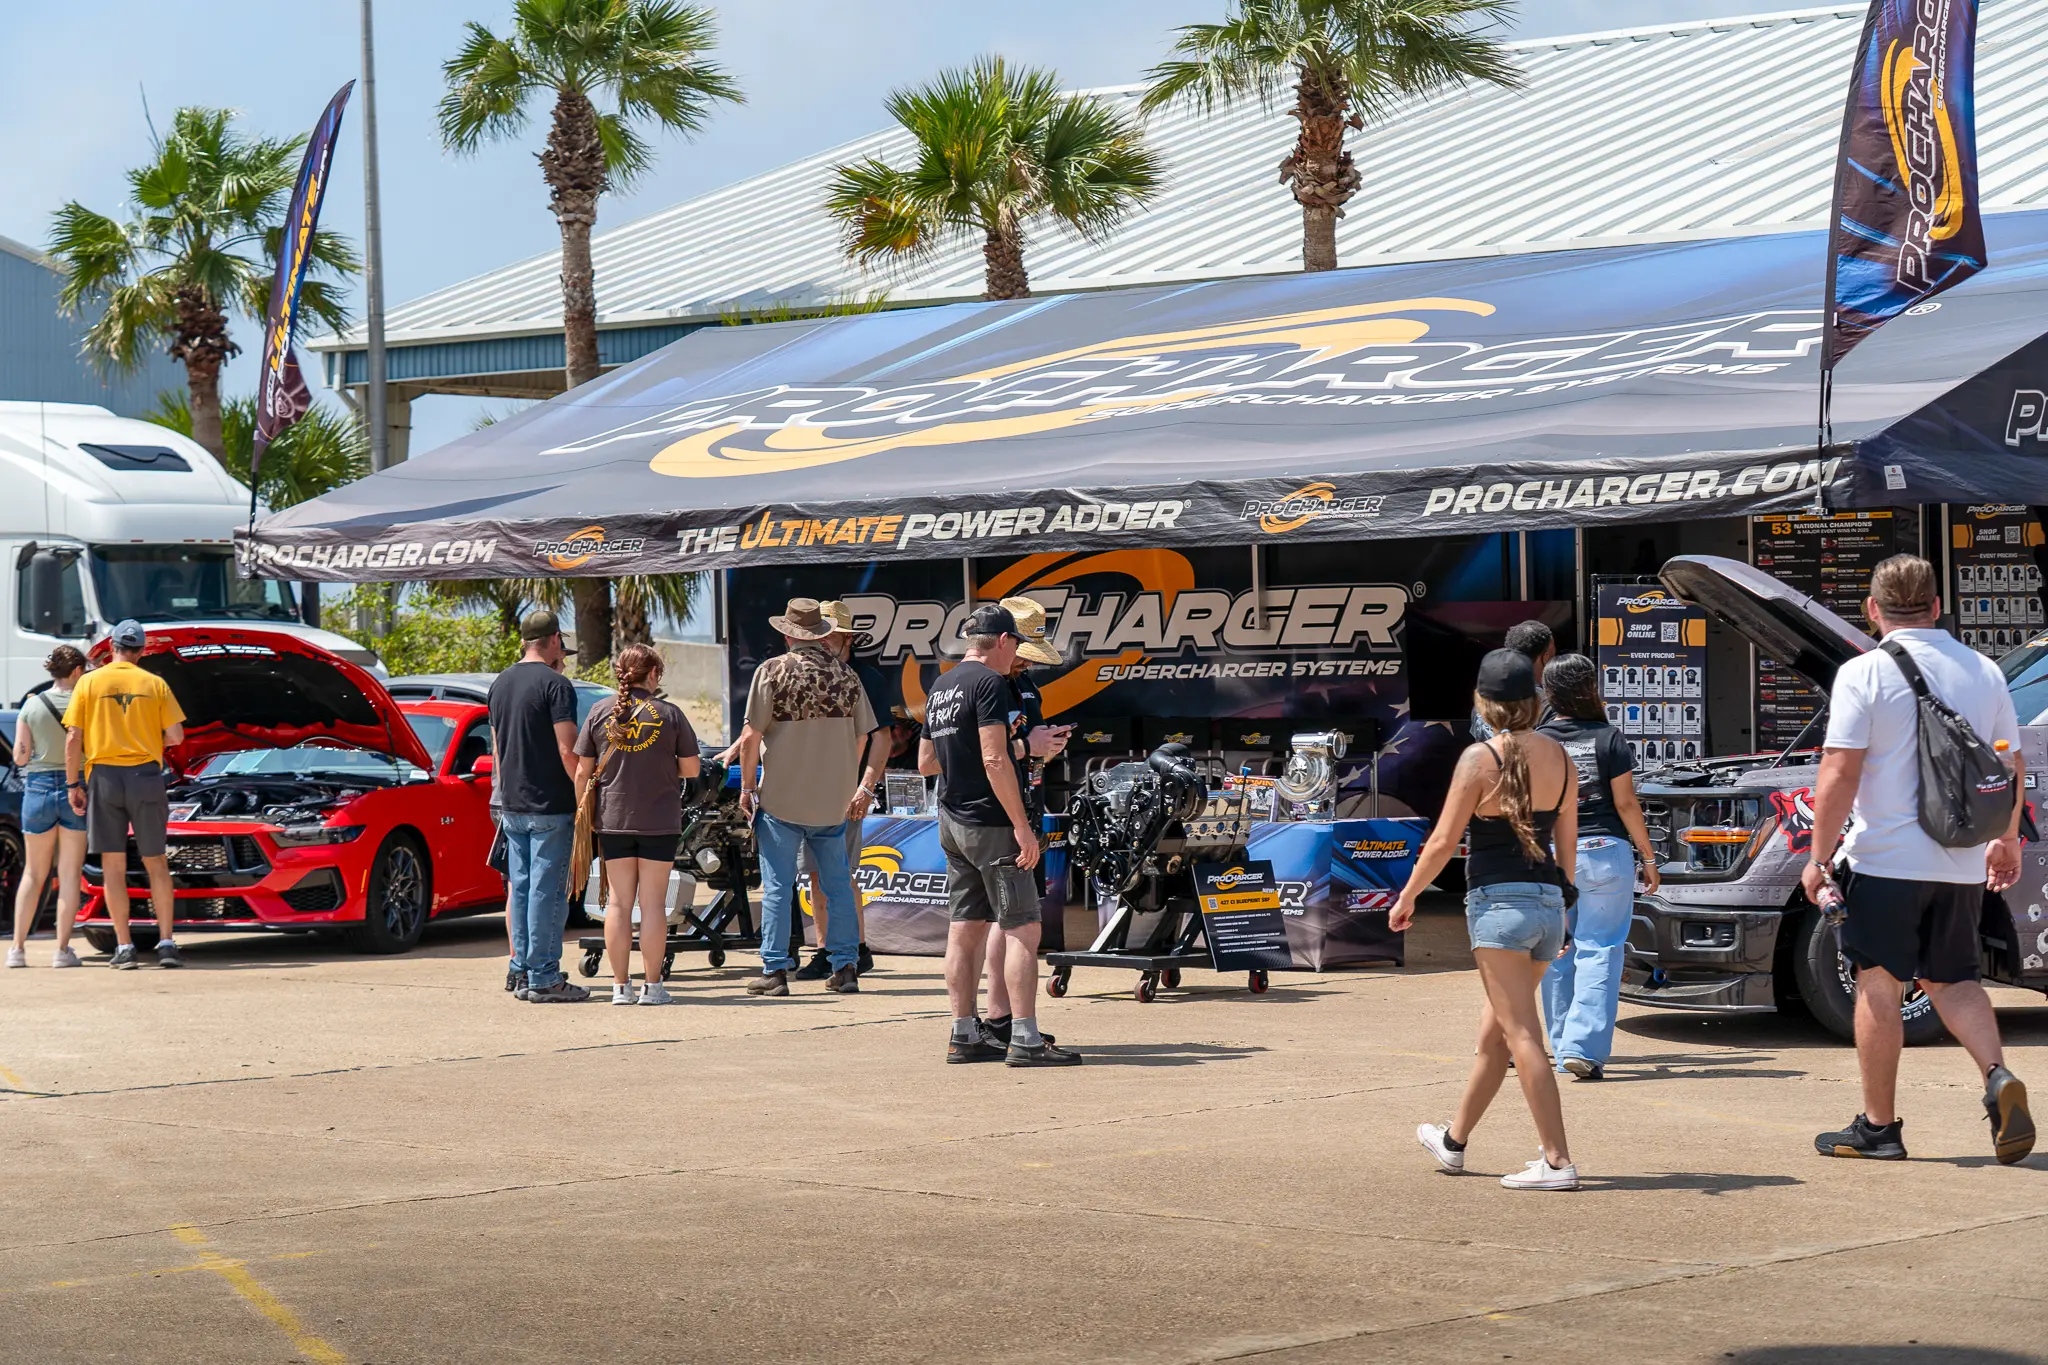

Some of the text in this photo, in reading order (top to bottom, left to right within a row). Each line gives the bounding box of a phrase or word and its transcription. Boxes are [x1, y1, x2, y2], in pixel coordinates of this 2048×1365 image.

[271, 174, 316, 371] ULTIMATE
[1083, 362, 1791, 421] SUPERCHARGER SYSTEMS
[1423, 456, 1843, 516] PROCHARGER.COM
[1240, 495, 1384, 520] PROCHARGER
[1967, 504, 2028, 514] PROCHARGER
[677, 500, 1186, 555] THE ULTIMATE POWER ADDER
[1771, 522, 1792, 535] 53
[1793, 522, 1829, 530] NATIONAL
[240, 538, 498, 568] PROCHARGER.COM
[532, 538, 645, 557] PROCHARGER
[1616, 596, 1683, 606] PROCHARGE
[1630, 623, 1653, 631] SHOP
[1097, 660, 1402, 681] SUPERCHARGER SYSTEMS
[635, 698, 660, 720] WTSON
[633, 729, 660, 752] COWBOYS
[1565, 741, 1592, 753] BOUGHT
[1351, 849, 1410, 860] POWER ADDER
[1355, 840, 1406, 851] ULTIMATE
[1207, 873, 1264, 884] PROCHARGER
[866, 895, 950, 906] SUPERCHARGER SYST
